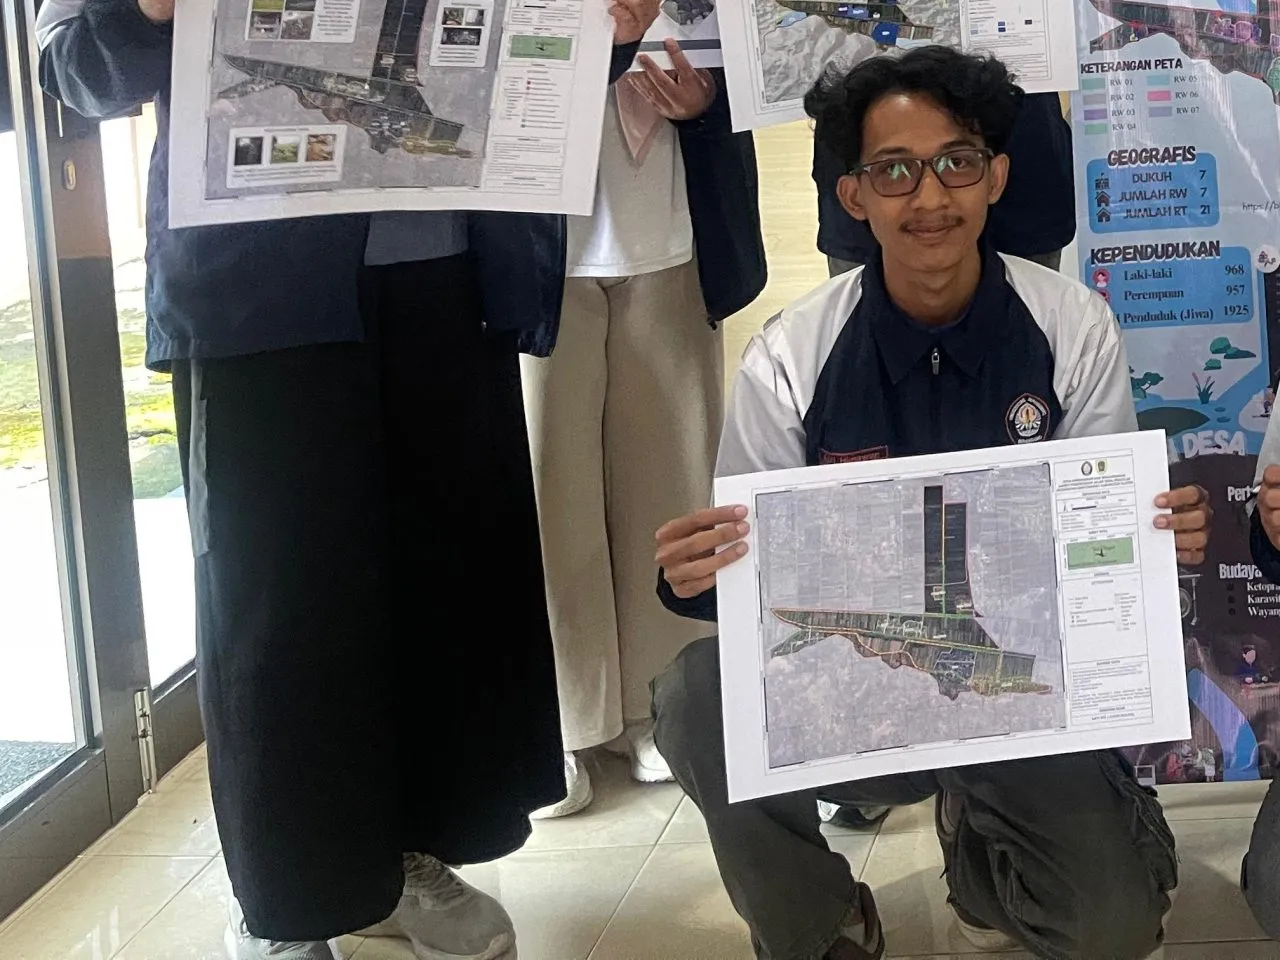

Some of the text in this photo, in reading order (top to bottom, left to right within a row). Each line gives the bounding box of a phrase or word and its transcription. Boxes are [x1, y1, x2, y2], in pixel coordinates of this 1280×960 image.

[1081, 58, 1183, 74] KETERANGAN PETA
[1110, 79, 1122, 87] RW
[1110, 93, 1134, 102] RW 02
[1175, 91, 1187, 99] RW
[1112, 109, 1124, 117] RW
[1190, 106, 1200, 114] 07
[1112, 123, 1124, 131] RW
[1108, 146, 1196, 167] GEOGRAFIS
[1132, 169, 1207, 184] DUKUH 7
[1119, 187, 1207, 202] JUMLAH RW 7
[1124, 204, 1211, 219] JUMLAH RT 21
[1091, 240, 1221, 266] KEPENDUDUKAN
[1124, 264, 1245, 281] Laki-laki 968
[1124, 284, 1245, 302] Perempuan 957
[1124, 311, 1177, 324] Penduduk
[1180, 308, 1214, 322] (Jiwa)
[1223, 304, 1249, 317] 1925
[1182, 429, 1246, 458] DESA
[1220, 563, 1263, 580] Budaya
